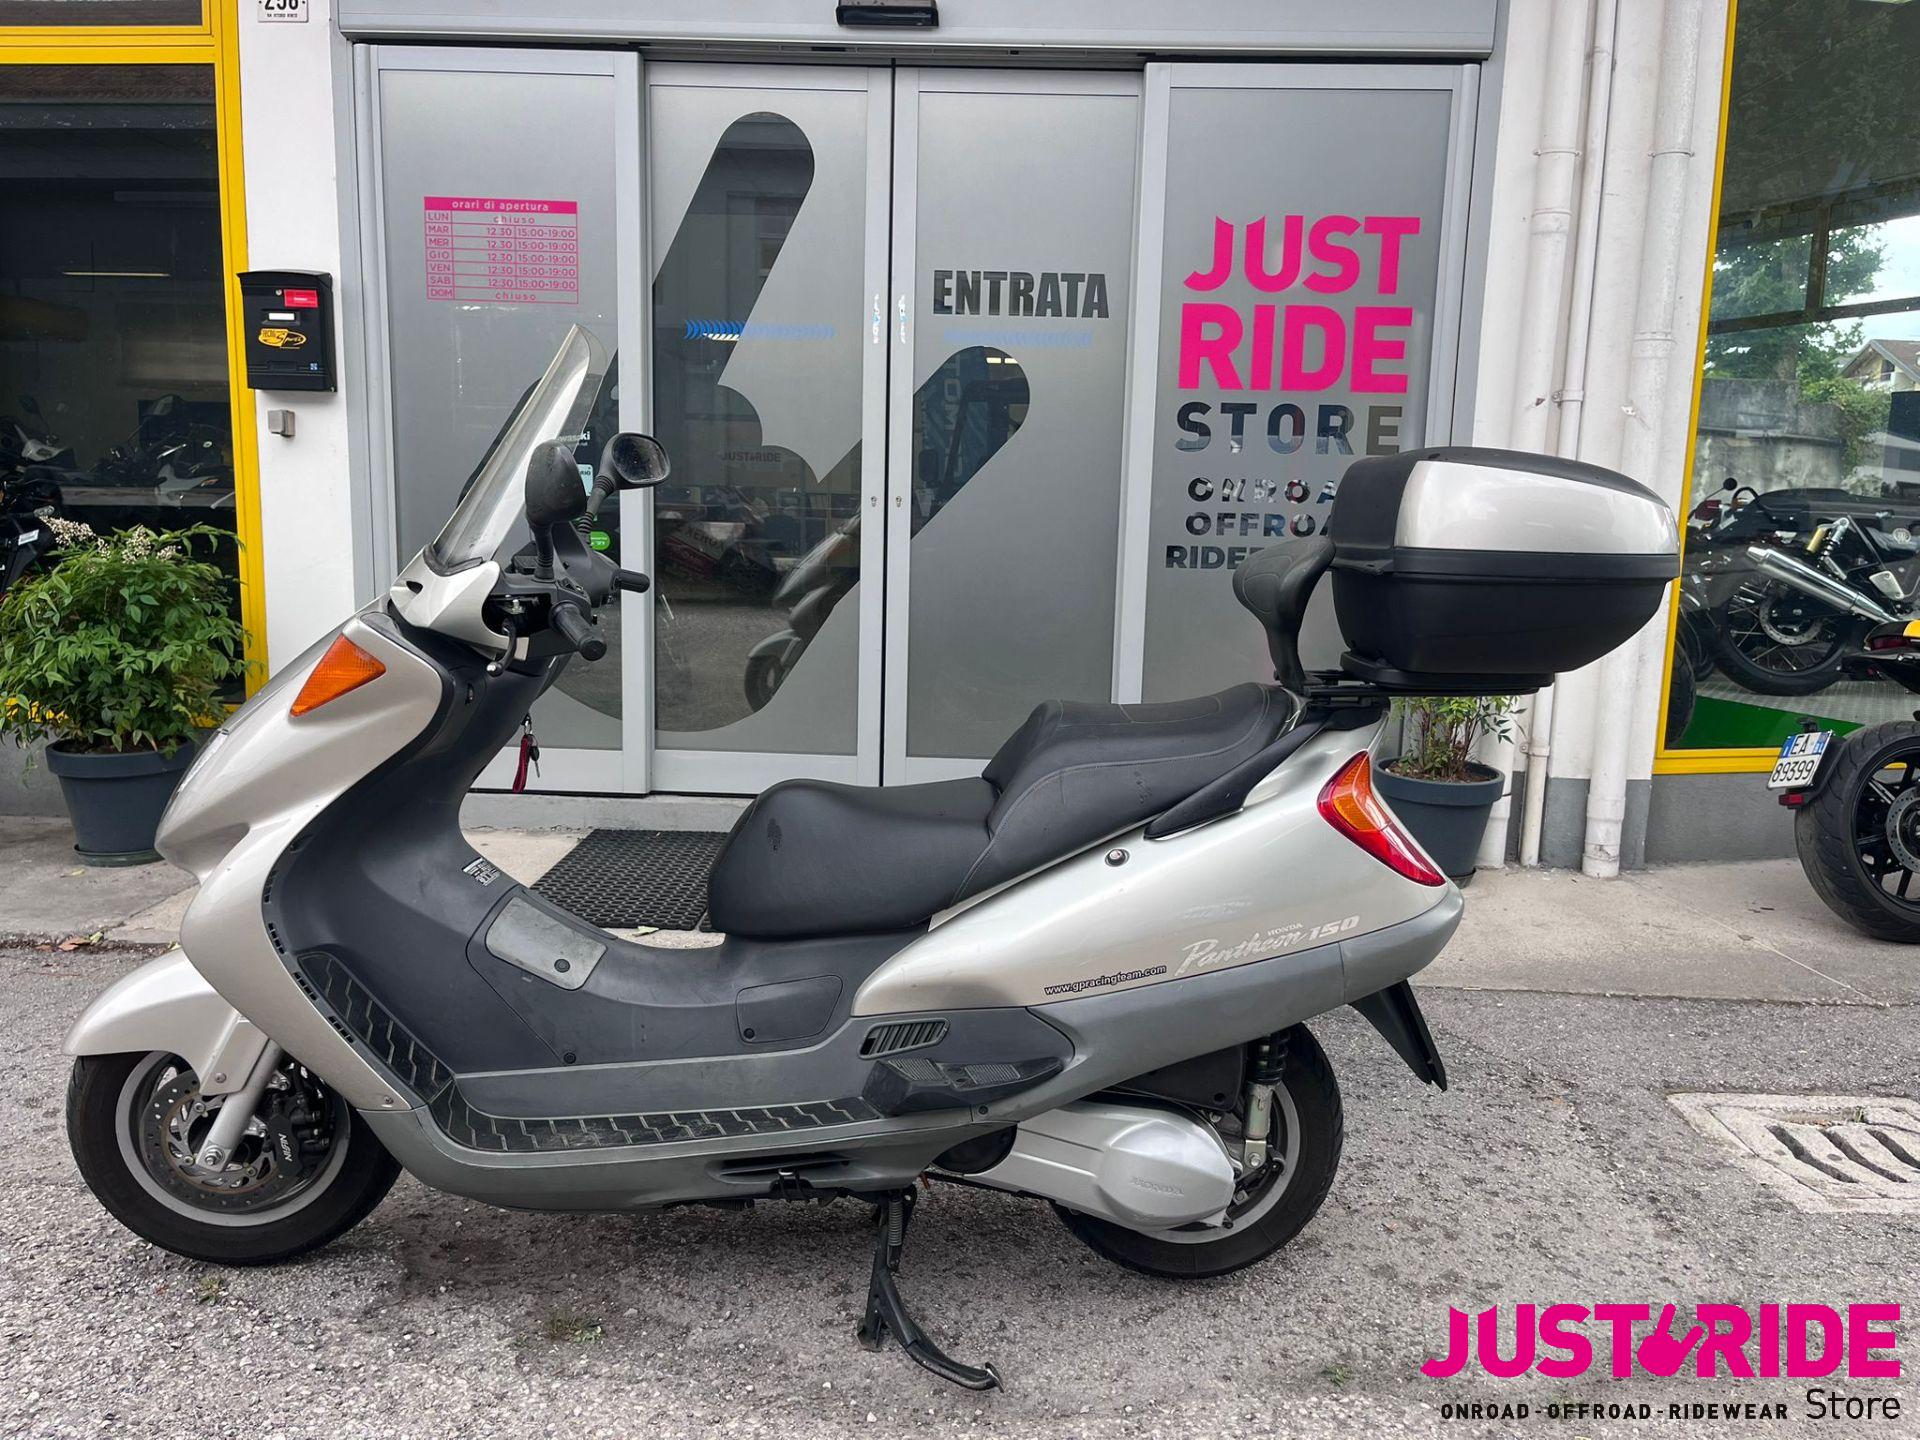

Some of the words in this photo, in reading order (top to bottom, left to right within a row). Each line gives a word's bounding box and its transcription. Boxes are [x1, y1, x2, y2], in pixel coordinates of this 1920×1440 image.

[452, 201, 479, 209] orari
[484, 201, 496, 210] di
[499, 203, 549, 212] apertura
[427, 211, 450, 221] LUN
[428, 224, 449, 234] MAR
[428, 237, 449, 247] MER
[429, 250, 450, 260] GIO
[1183, 215, 1421, 295] JUST
[429, 263, 451, 272] VEN
[430, 275, 451, 285] SAB
[495, 292, 537, 301] chiuso
[933, 269, 1109, 319] ENTRATA
[1177, 302, 1414, 394] RIDE
[1175, 401, 1404, 456] STORE
[721, 452, 751, 463] JUST
[1791, 734, 1810, 755] EA
[1772, 760, 1815, 783] 89399
[1267, 923, 1303, 937] HONDA
[1175, 932, 1308, 977] Pantheon
[1309, 915, 1360, 941] 150
[1044, 965, 1167, 996] www.gpracingteam.com
